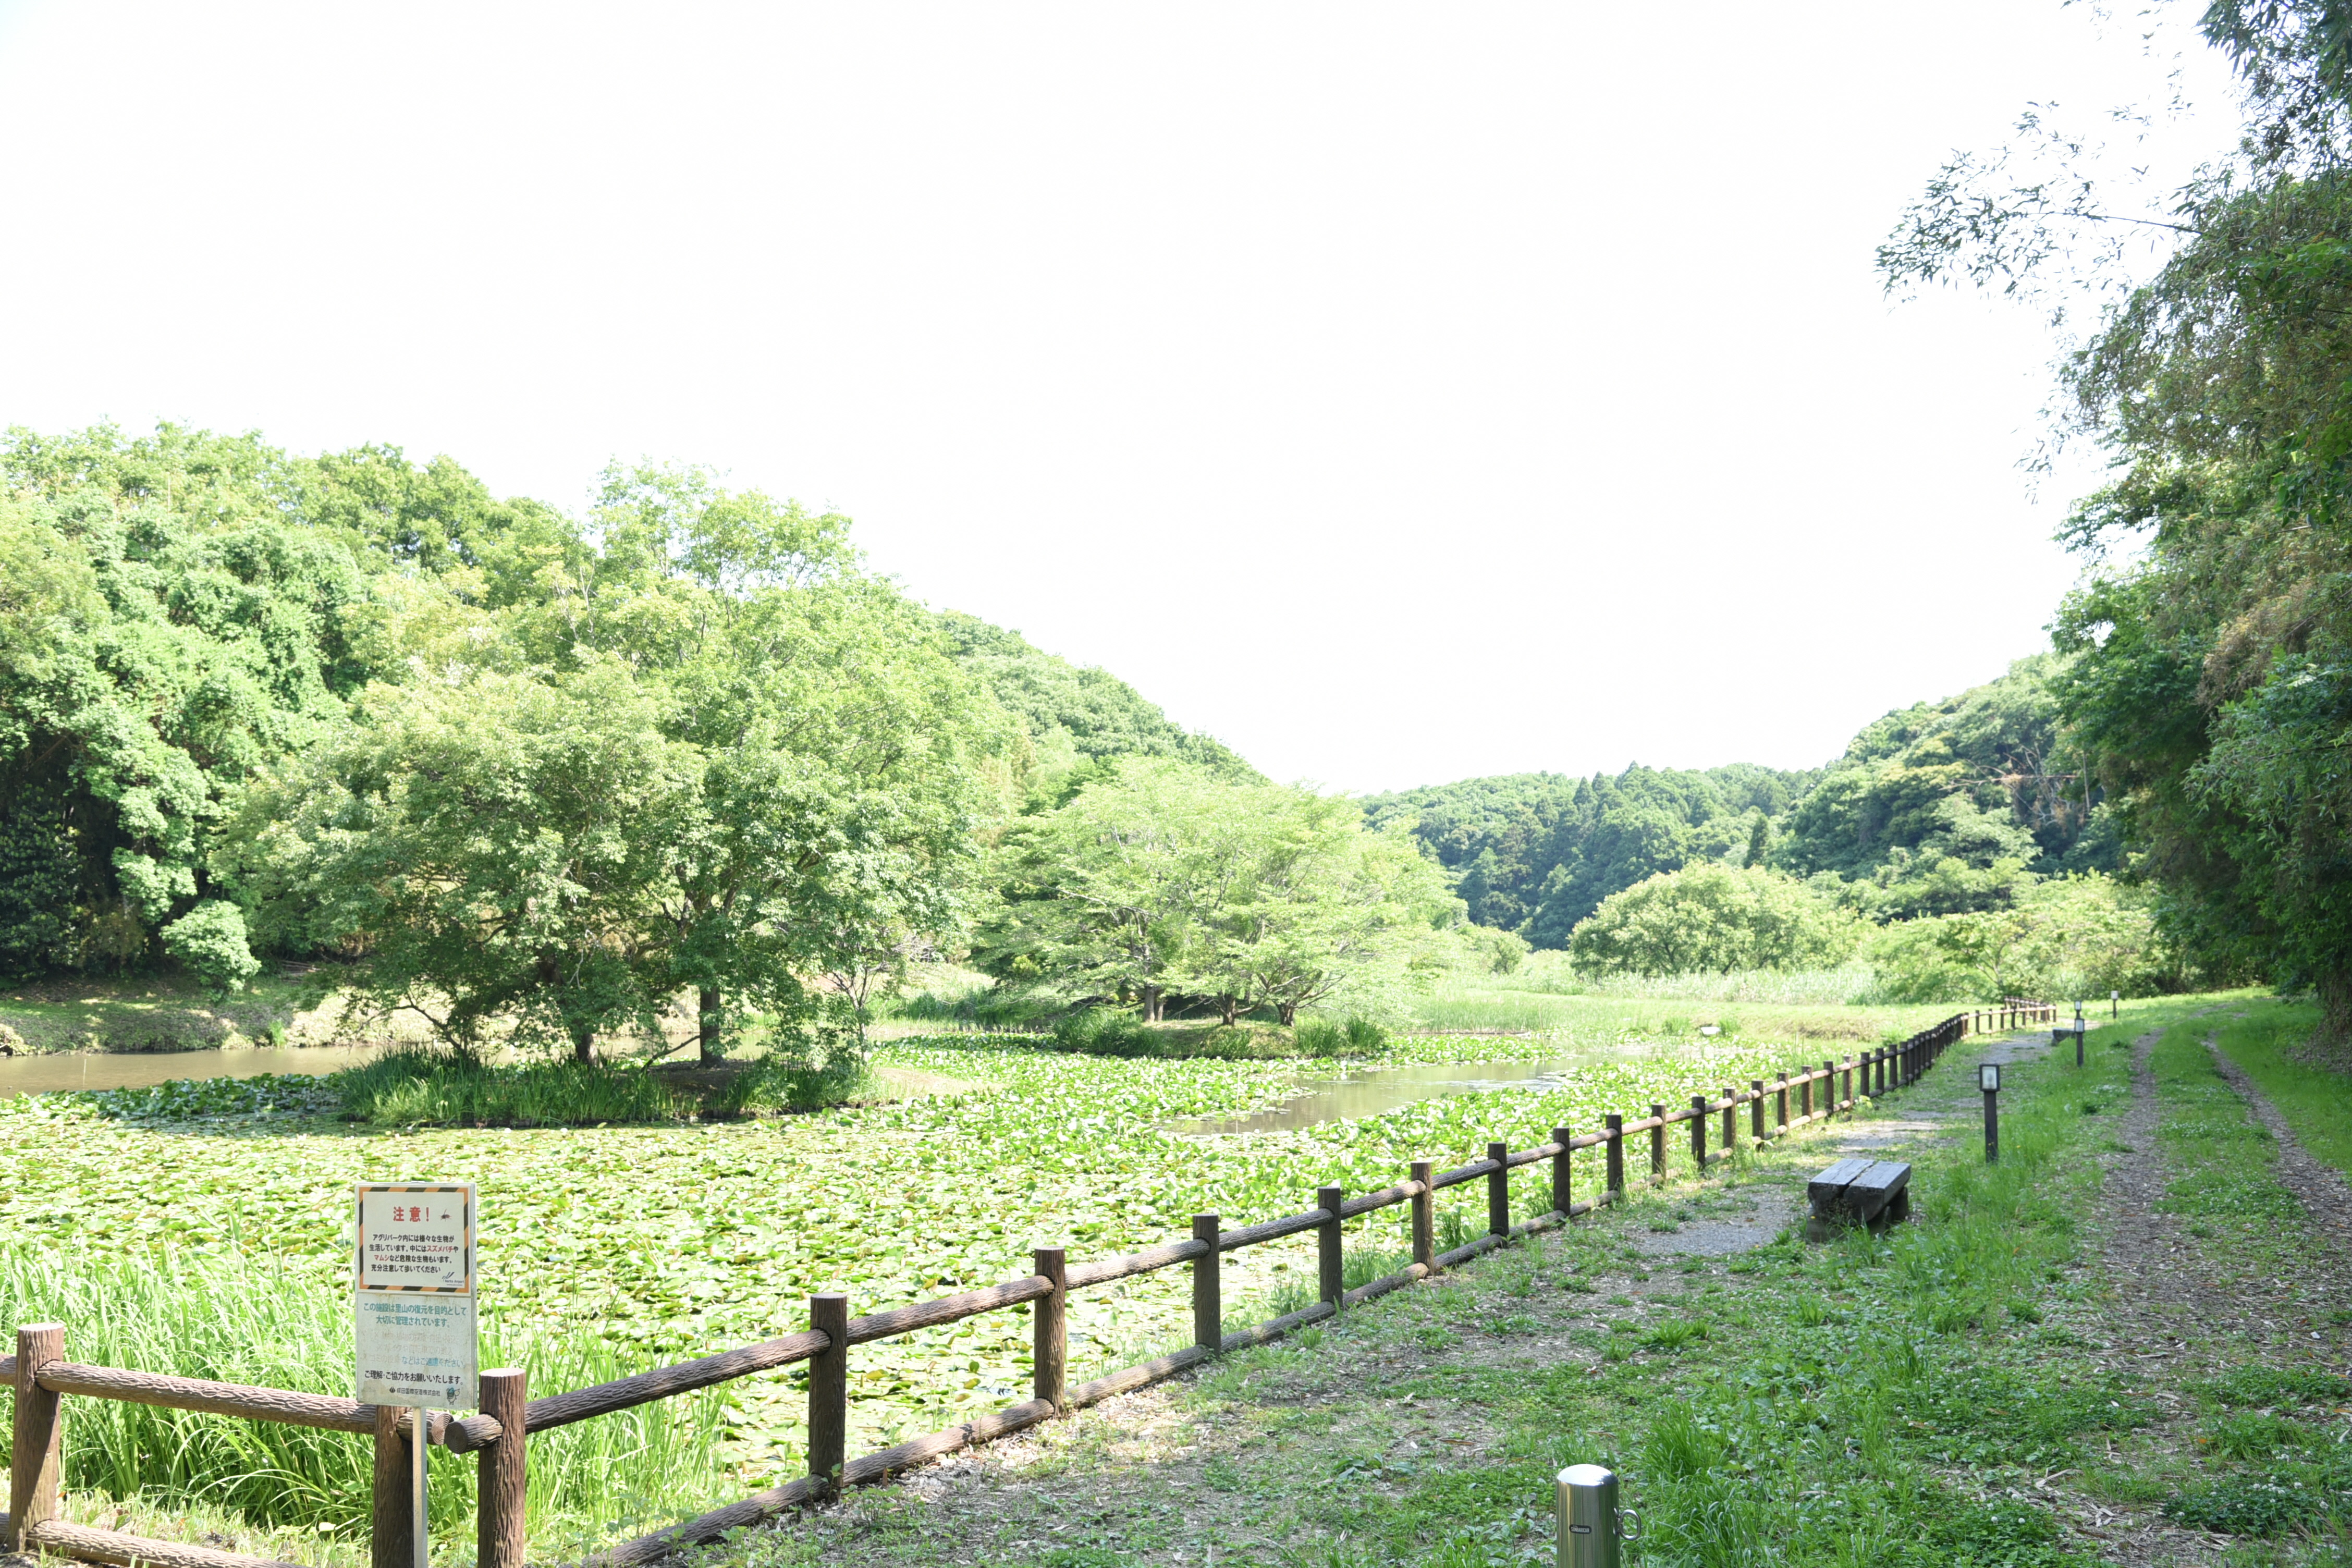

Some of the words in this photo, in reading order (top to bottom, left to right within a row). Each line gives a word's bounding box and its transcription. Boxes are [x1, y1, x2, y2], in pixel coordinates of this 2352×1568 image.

[373, 1234, 455, 1243] アグリパーク内には様々な生物が
[374, 1254, 452, 1264] マムシなど危険な生物もいます。
[371, 1264, 440, 1273] 充分注意して歩いてください
[363, 1303, 467, 1316] この施設は里山の復元を目的として
[376, 1315, 450, 1328] 大切に管理されています。
[396, 1388, 440, 1397] 成田国際空港株式会社
